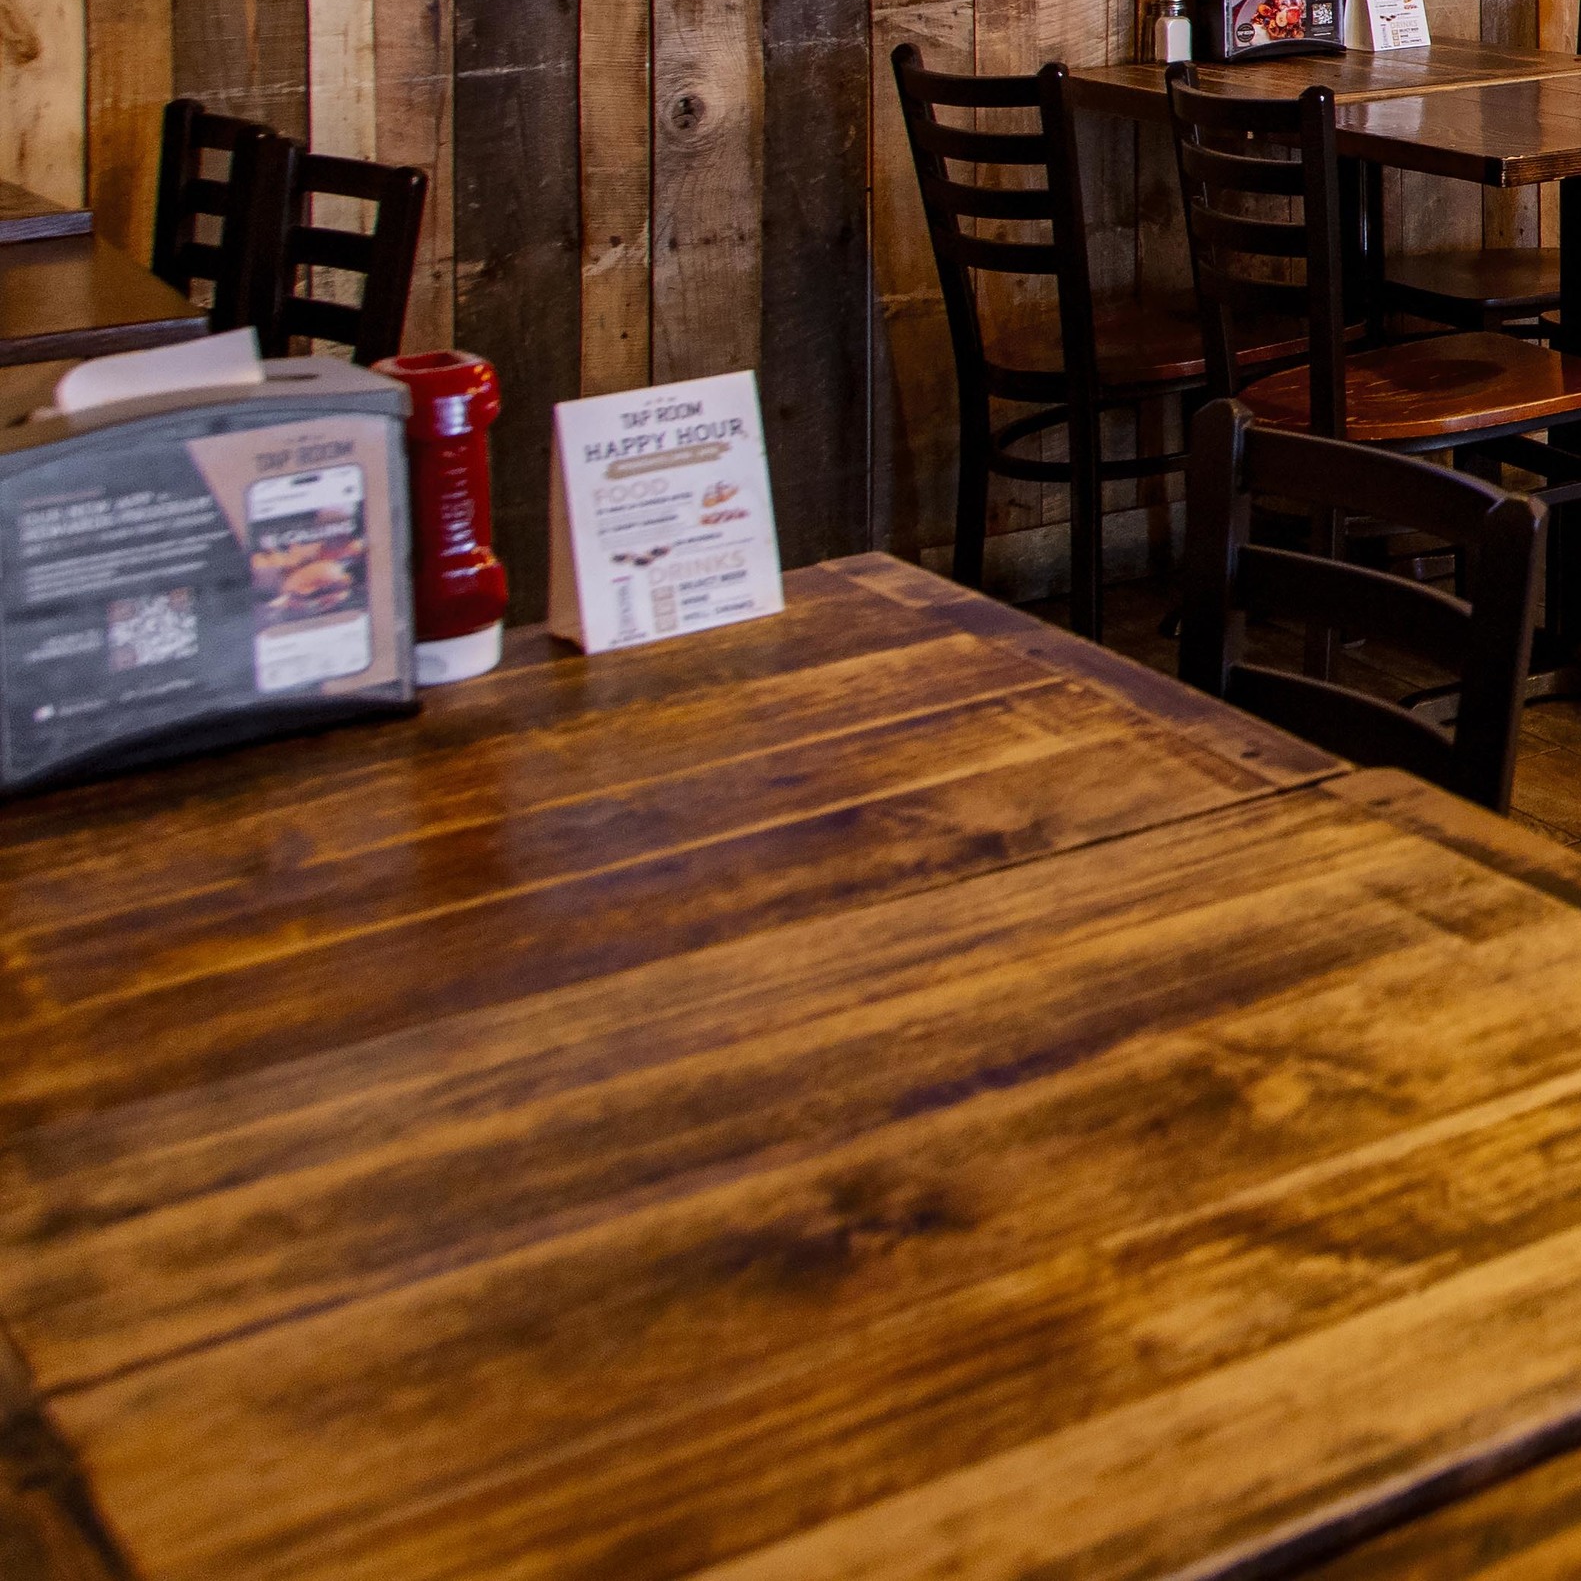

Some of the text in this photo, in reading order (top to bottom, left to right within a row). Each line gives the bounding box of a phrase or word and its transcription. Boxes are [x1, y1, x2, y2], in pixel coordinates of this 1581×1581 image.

[655, 400, 702, 421] ROOM
[584, 418, 744, 463] HAPPY HOUR
[594, 477, 669, 503] FOOD
[650, 551, 744, 584] DRINKS
